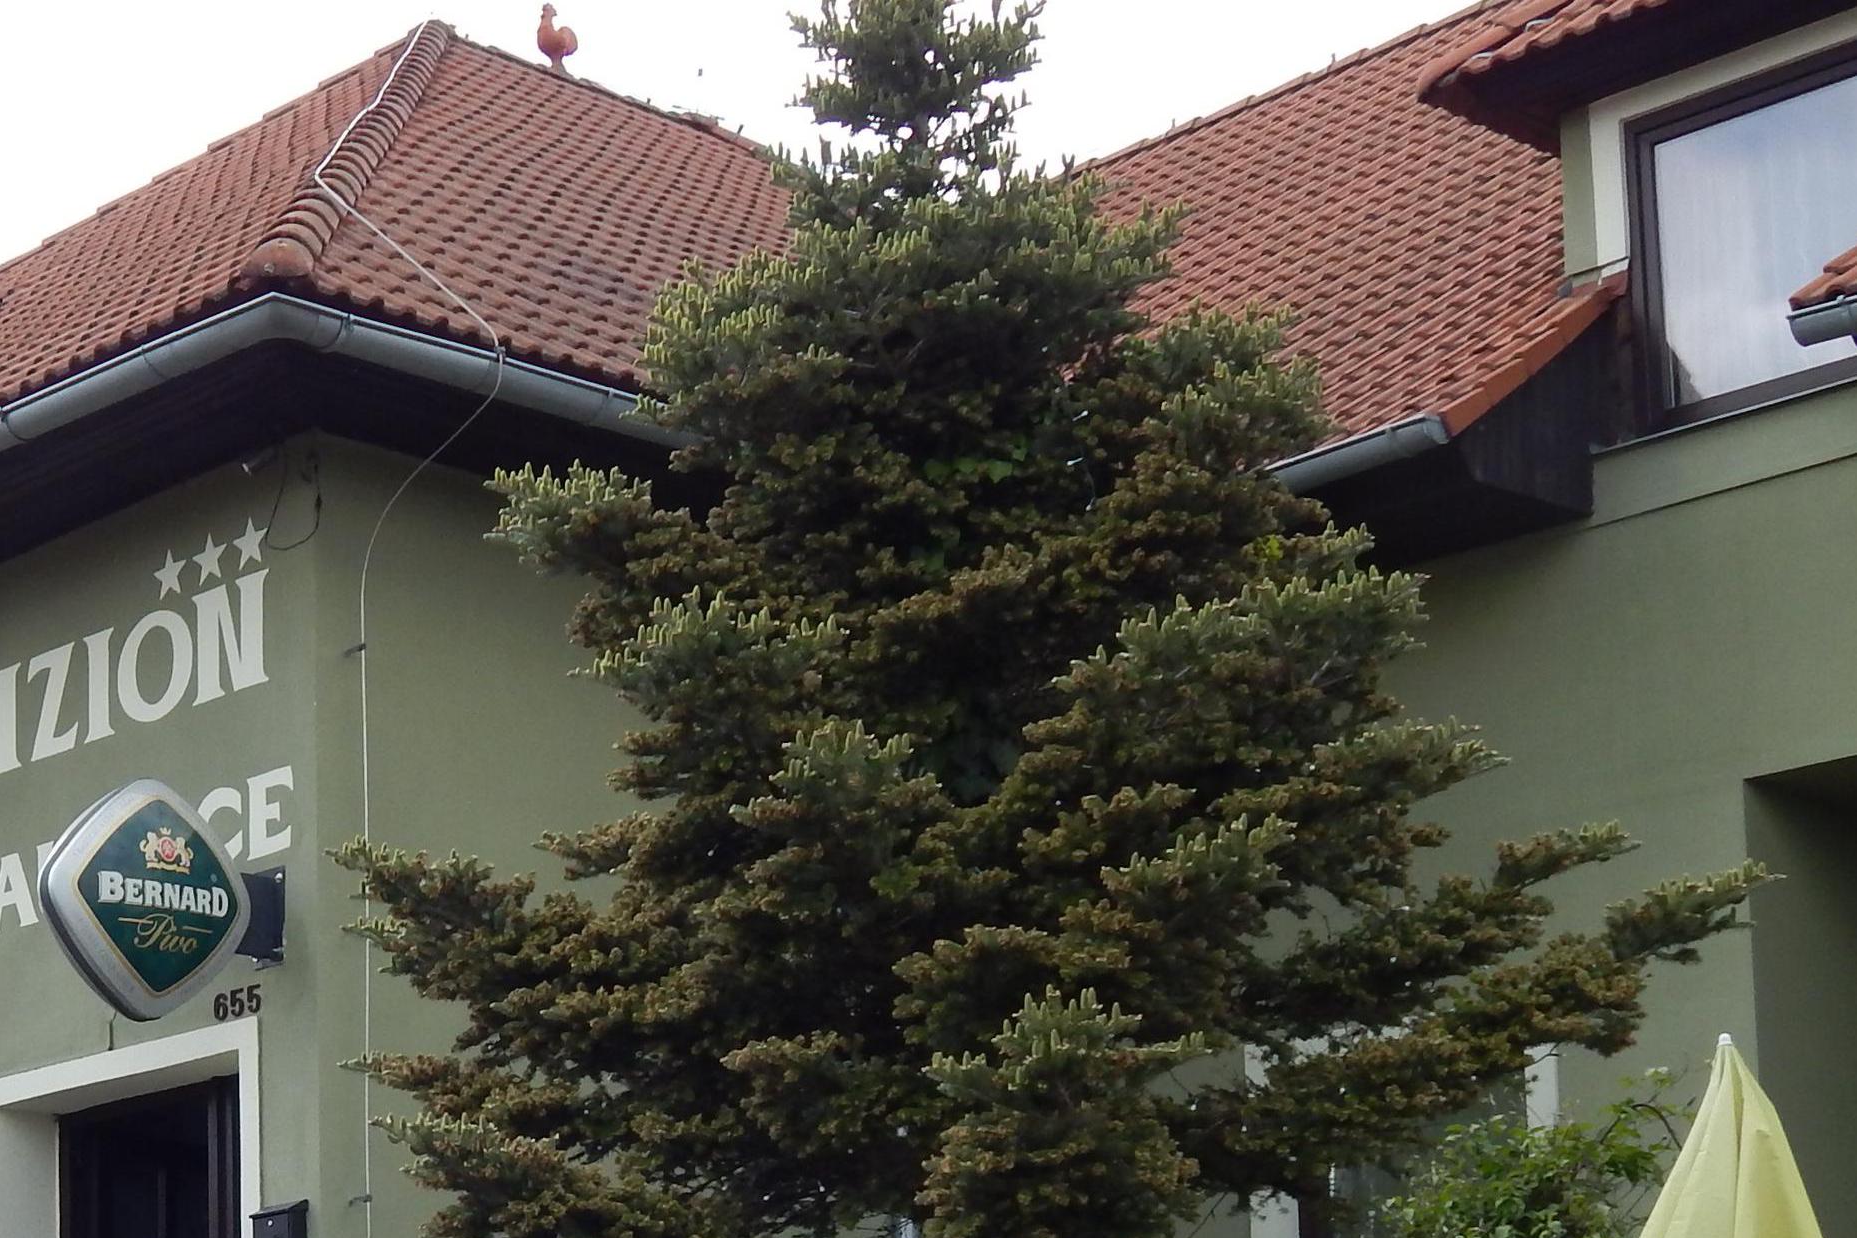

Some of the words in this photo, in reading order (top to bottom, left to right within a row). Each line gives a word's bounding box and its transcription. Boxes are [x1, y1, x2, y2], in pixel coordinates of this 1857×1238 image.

[98, 871, 228, 918] BERNARD
[134, 913, 198, 954] Pivo
[214, 984, 262, 1021] 655
